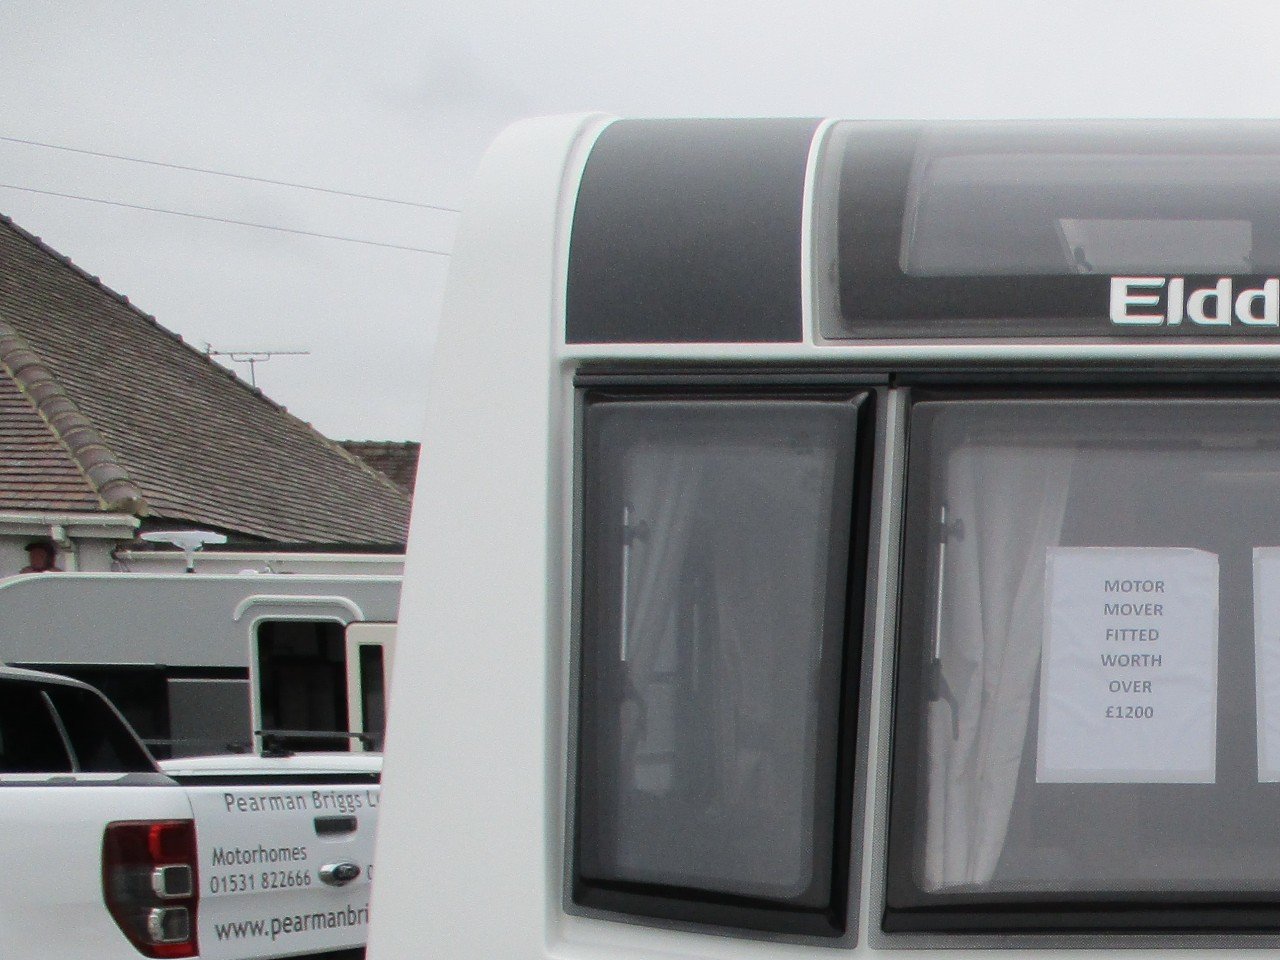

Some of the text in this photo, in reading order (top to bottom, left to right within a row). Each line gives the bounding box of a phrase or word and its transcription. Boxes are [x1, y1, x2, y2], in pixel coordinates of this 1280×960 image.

[1103, 579, 1165, 594] MOTOR
[1103, 603, 1164, 617] MOVER
[1105, 628, 1160, 642] FITTED
[1100, 653, 1162, 667] WORTH
[1108, 679, 1153, 694] OVER
[1104, 705, 1154, 720] £1200
[224, 792, 307, 813] Pearman
[311, 790, 362, 814] Briggs
[212, 845, 308, 867] Motorhomes
[210, 871, 312, 894] 01531 822666
